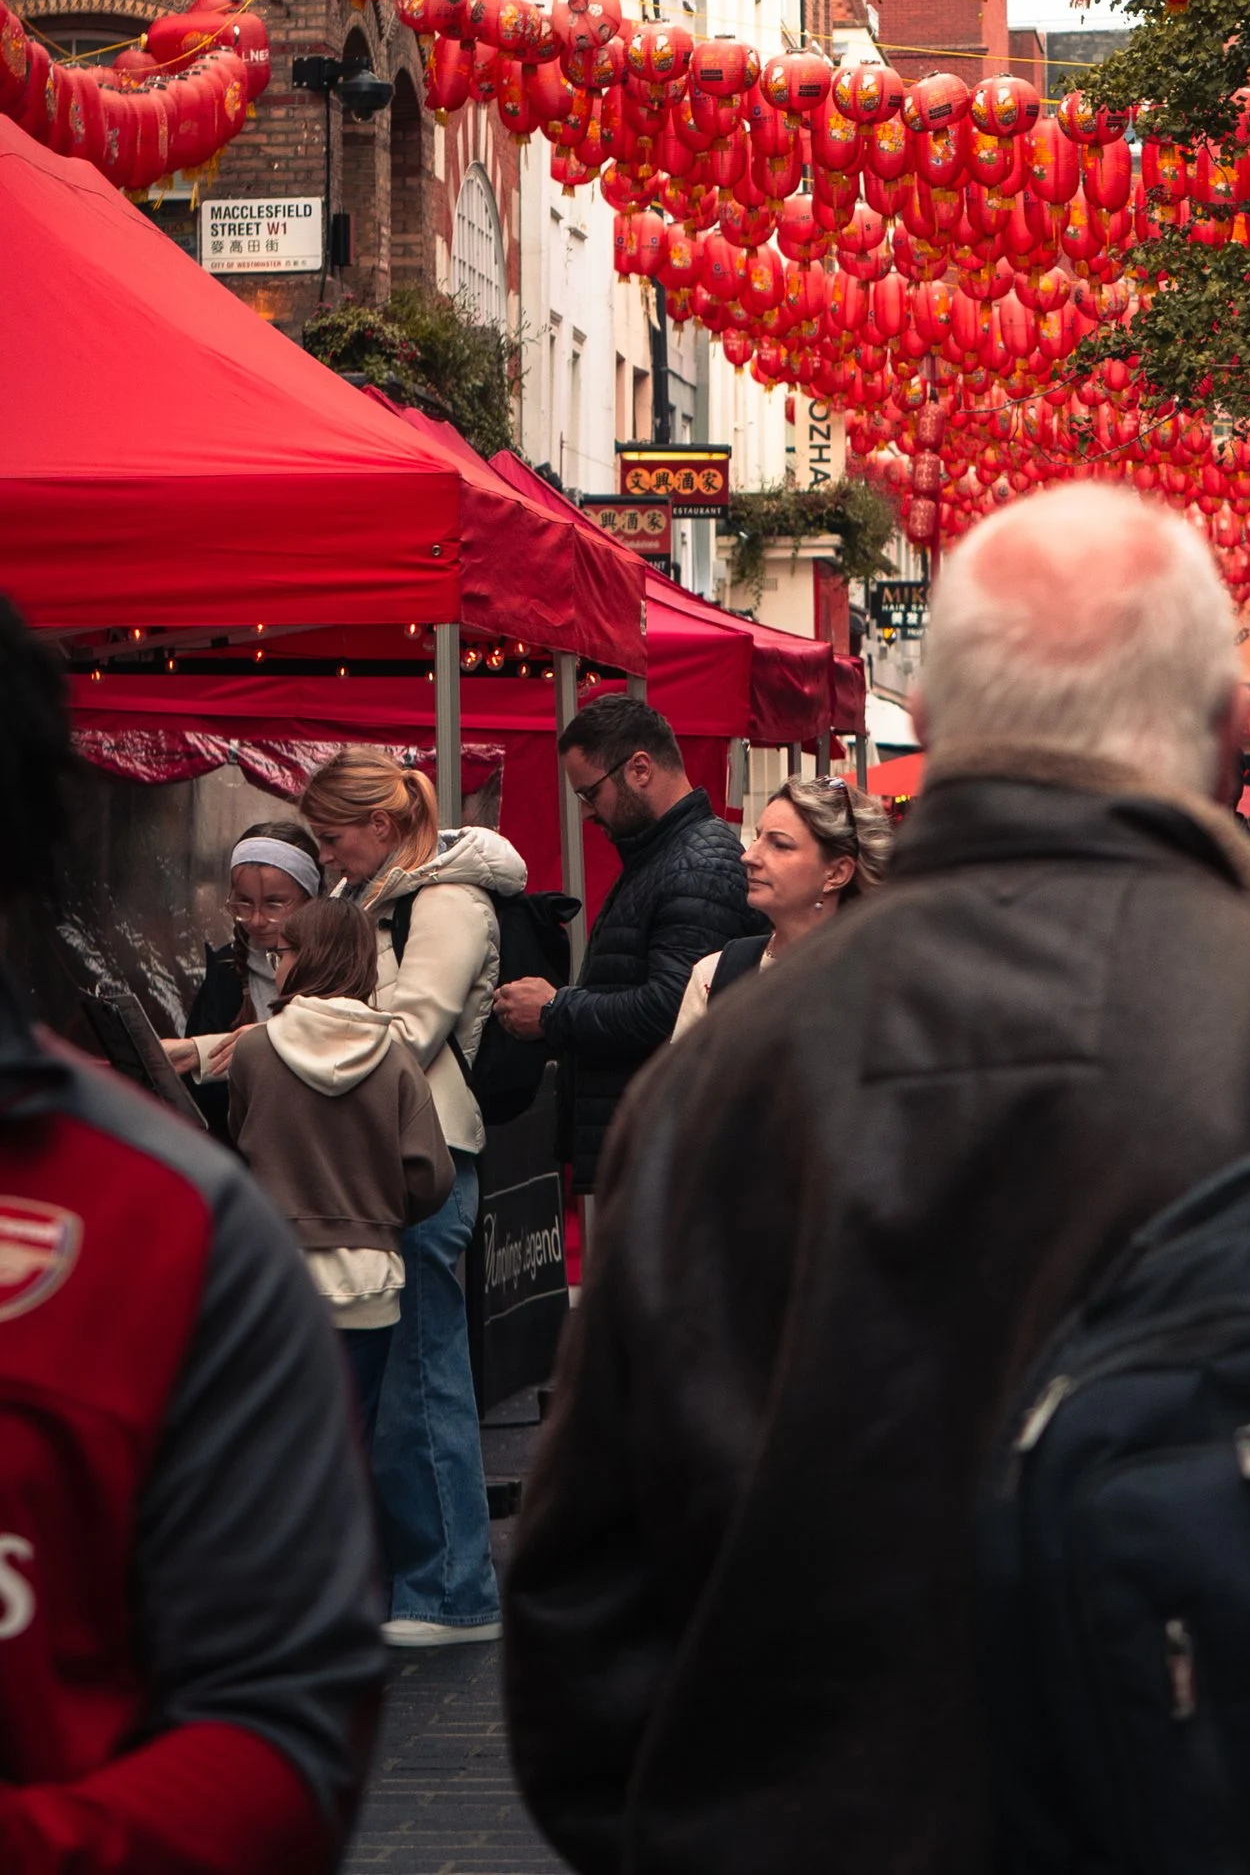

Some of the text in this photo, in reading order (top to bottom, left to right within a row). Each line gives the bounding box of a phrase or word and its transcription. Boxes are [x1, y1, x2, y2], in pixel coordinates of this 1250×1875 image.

[210, 204, 312, 220] MACCLESFIELD
[210, 222, 288, 237] STREET W1
[629, 469, 720, 493] 文興酒家
[672, 506, 722, 515] ESTAURANT
[882, 587, 930, 603] MIK
